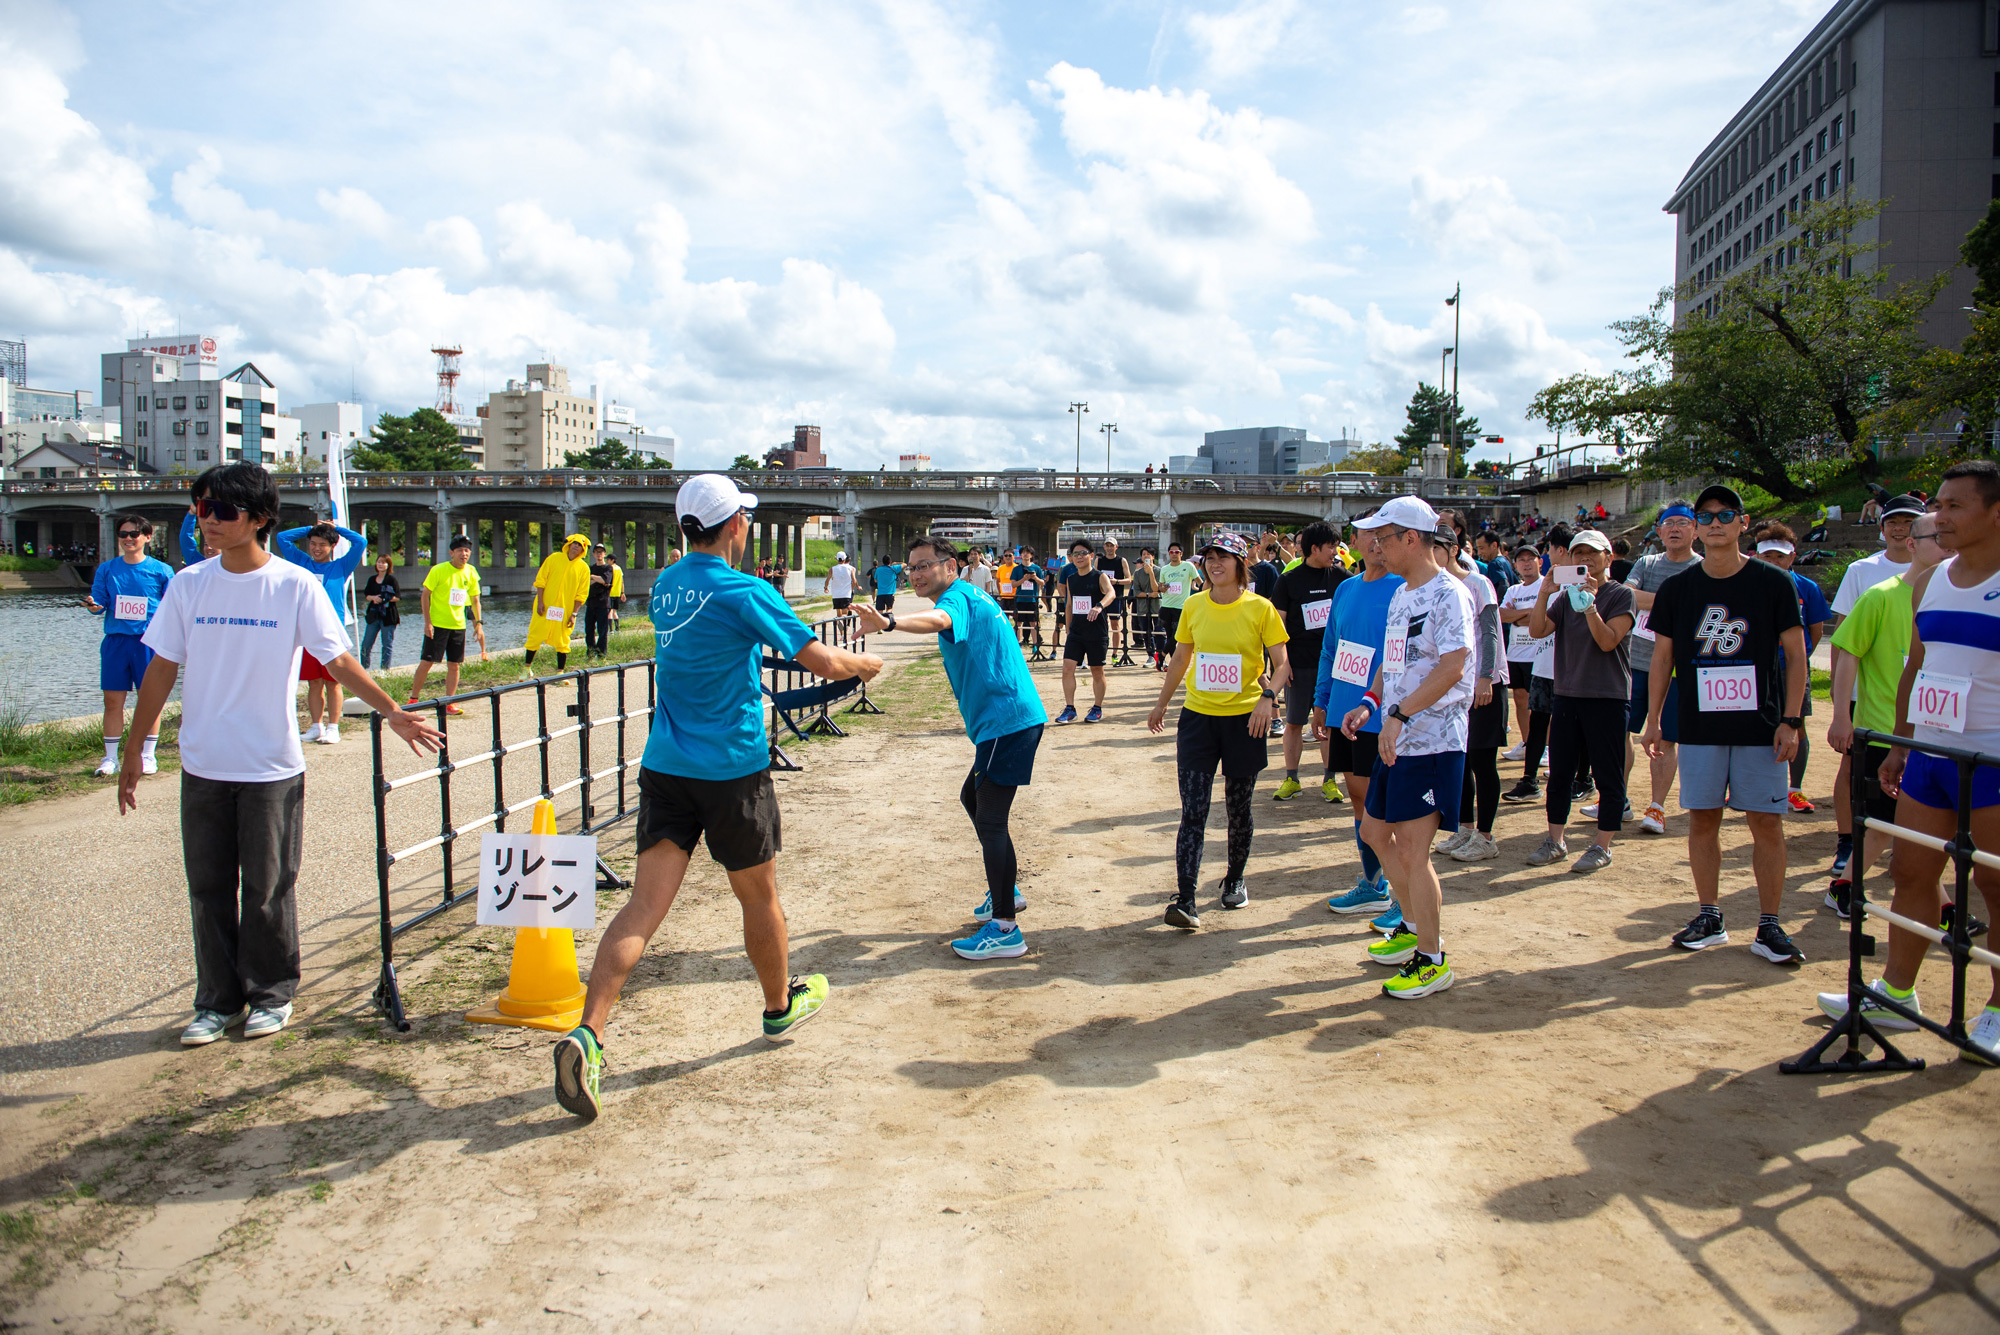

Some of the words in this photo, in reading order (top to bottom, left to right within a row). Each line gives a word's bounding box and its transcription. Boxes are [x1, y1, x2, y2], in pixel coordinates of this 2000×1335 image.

[119, 601, 146, 616] 1068
[1074, 600, 1090, 611] 1081
[195, 616, 206, 625] HE
[206, 616, 219, 625] JOY
[259, 619, 278, 629] HERE
[1386, 638, 1405, 662] 1053
[1200, 663, 1239, 685] 1088
[1337, 651, 1369, 677] 1068
[1704, 678, 1752, 701] 1030
[1918, 686, 1959, 719] 1071
[495, 847, 578, 877] リレー
[493, 880, 579, 914] ゾーン
[1419, 967, 1438, 984] HOKA
